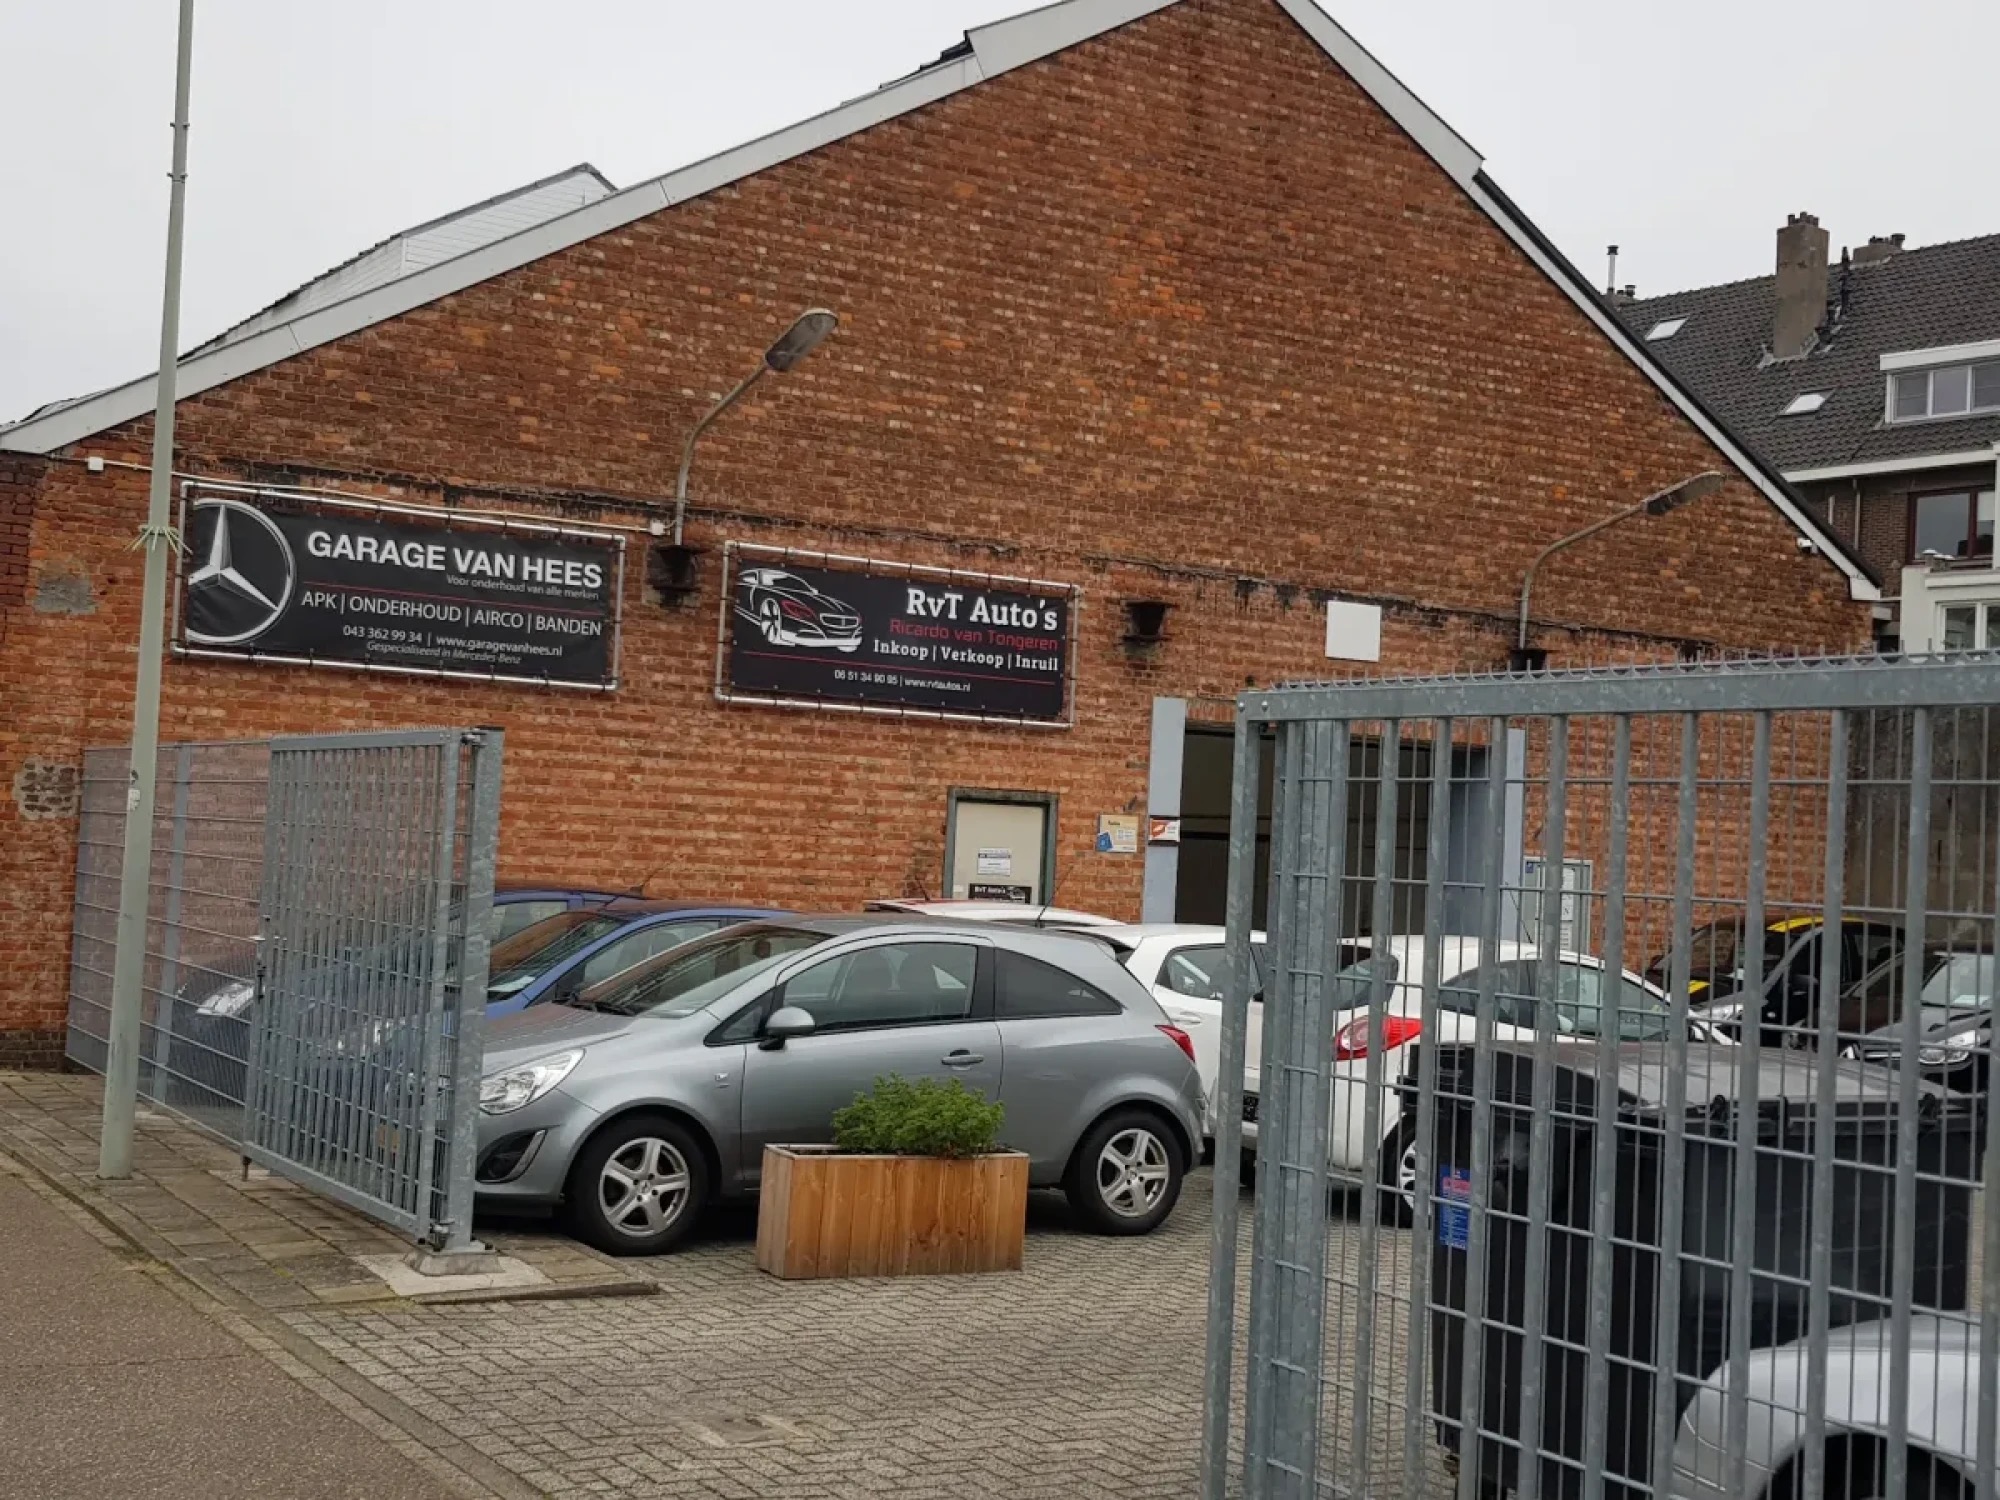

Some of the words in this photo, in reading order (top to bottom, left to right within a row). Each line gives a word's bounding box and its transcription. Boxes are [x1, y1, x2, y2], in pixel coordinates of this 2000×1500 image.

[307, 531, 446, 571] GARAGE
[452, 547, 516, 580] VAN
[522, 555, 602, 588] HEES
[446, 573, 469, 586] Voor
[471, 578, 526, 592] onderhoud
[527, 586, 544, 595] van
[545, 585, 562, 597] alle
[564, 589, 599, 601] merken
[301, 591, 338, 609] APK
[349, 596, 461, 623] ONDERHOUD
[473, 609, 524, 629] AIRCO
[535, 615, 601, 636] BANDEN
[906, 588, 963, 620] RvT
[970, 596, 1058, 631] Auto's
[343, 624, 366, 639] 043
[367, 627, 389, 641] 362
[391, 629, 407, 643] 99
[408, 630, 423, 644] 34
[436, 634, 563, 657] www.garagevanhees.nl
[366, 641, 440, 657] Gespecialiseerd
[442, 648, 451, 658] in
[890, 618, 949, 639] Ricardo
[954, 630, 982, 643] van
[987, 630, 1058, 651] Tongeren
[874, 639, 929, 660] Inkoop
[941, 648, 1004, 668] Verkoop
[1015, 654, 1058, 671] Inruil
[834, 669, 846, 680] 06
[848, 671, 858, 681] 51
